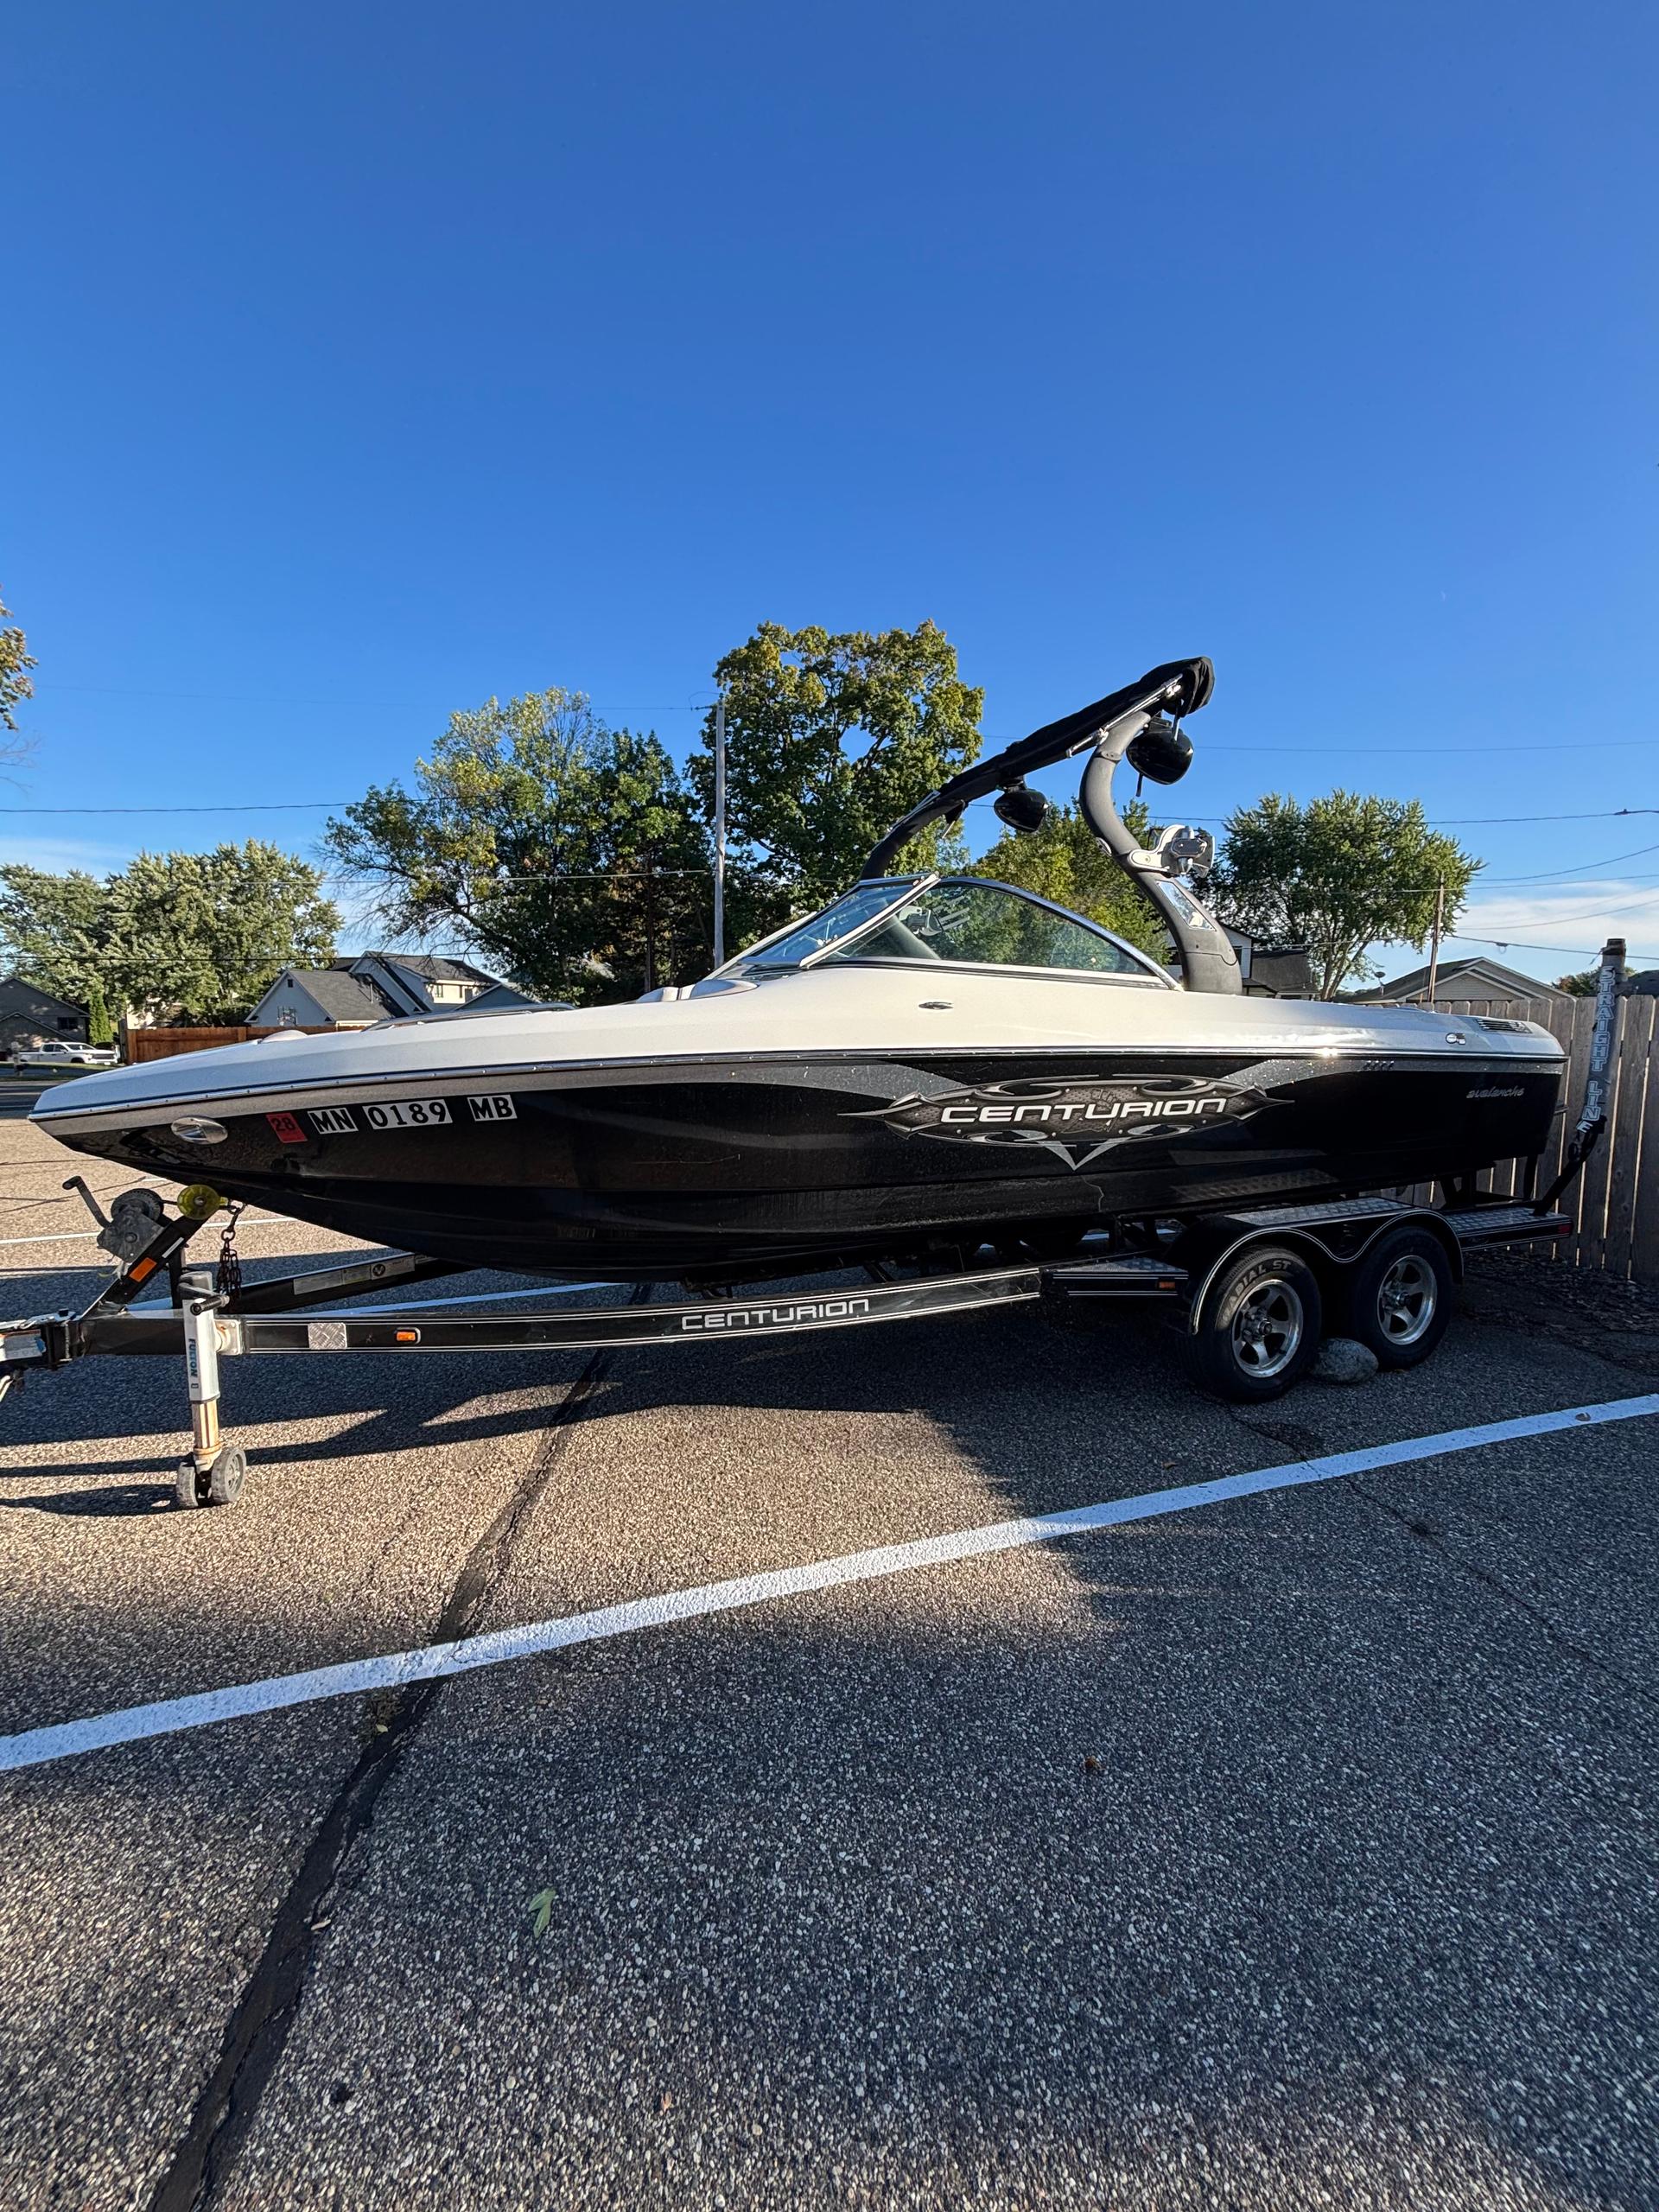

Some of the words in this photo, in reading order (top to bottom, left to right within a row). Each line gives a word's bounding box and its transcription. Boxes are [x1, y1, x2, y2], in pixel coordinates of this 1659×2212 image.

[1592, 966, 1616, 1071] STRAIGHT
[272, 1117, 296, 1131] 28
[310, 1109, 354, 1133] MN
[368, 1102, 446, 1128] 0189
[469, 1096, 513, 1119] MB
[940, 1098, 1227, 1123] CENTURION
[1577, 1081, 1602, 1134] LINE
[1273, 1260, 1291, 1270] ST
[682, 1299, 869, 1331] CENTURION
[188, 1338, 198, 1378] FULTON
